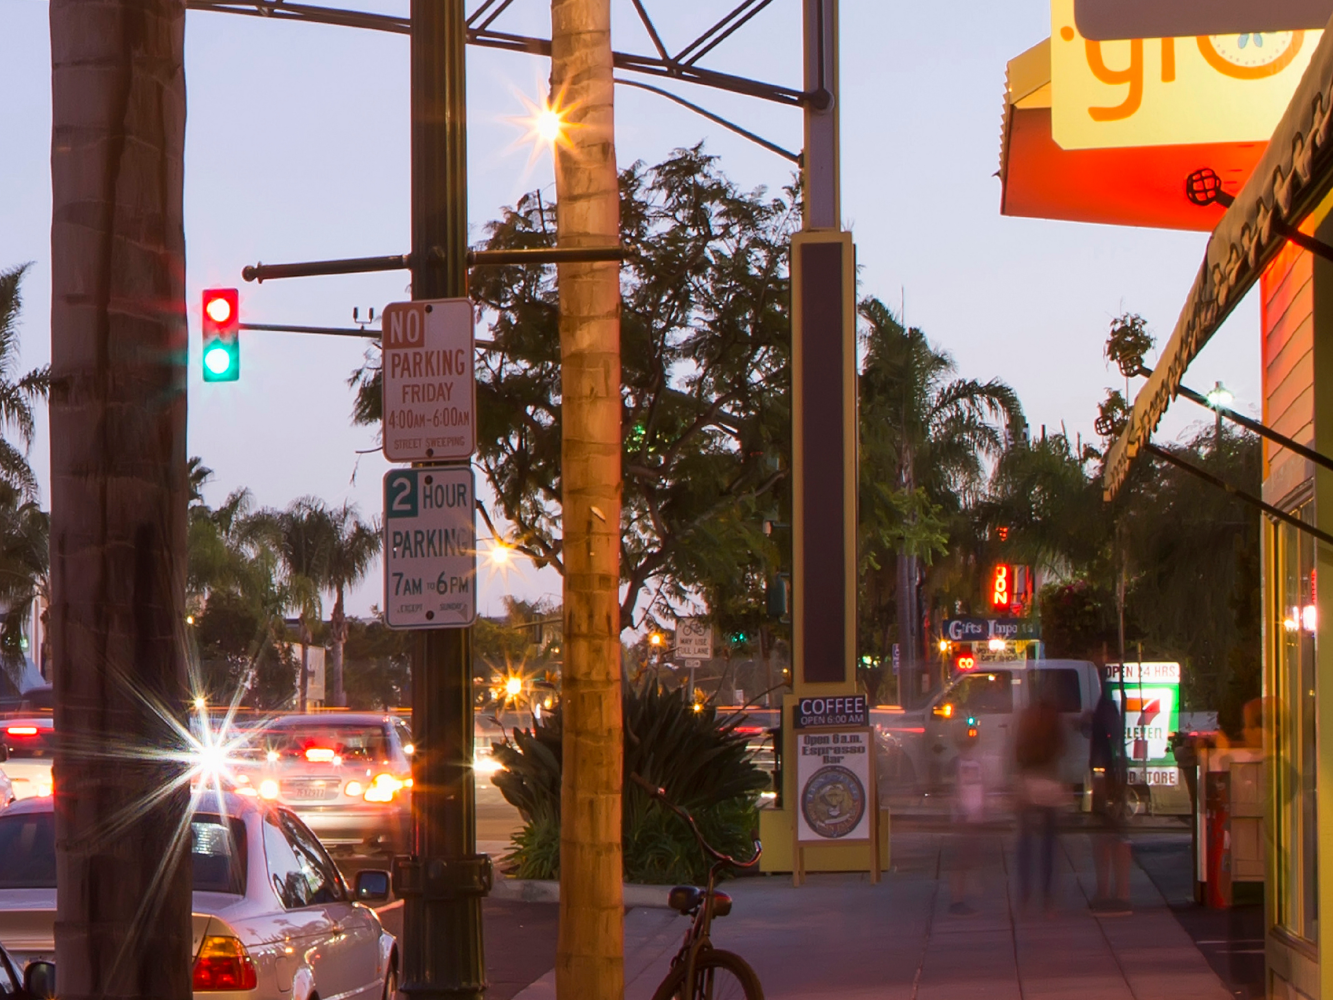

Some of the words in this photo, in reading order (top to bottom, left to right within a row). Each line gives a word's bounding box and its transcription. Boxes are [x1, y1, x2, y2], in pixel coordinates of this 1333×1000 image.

[390, 309, 420, 344] NO
[391, 349, 466, 379] PARKING
[402, 382, 454, 404] FRIDAY
[394, 438, 422, 450] STREET
[425, 436, 466, 449] SWEEPING
[392, 477, 412, 511] 2
[423, 483, 467, 510] HOUR
[393, 528, 468, 559] PARKING
[948, 620, 982, 640] Gifts
[987, 620, 1034, 640] Impots
[1106, 666, 1133, 678] OPN
[801, 698, 864, 715] COFFEE
[801, 716, 825, 726] OPEN
[848, 714, 864, 723] AM
[804, 735, 830, 746] Open
[802, 746, 866, 757] Espresso
[823, 756, 845, 764] Bar
